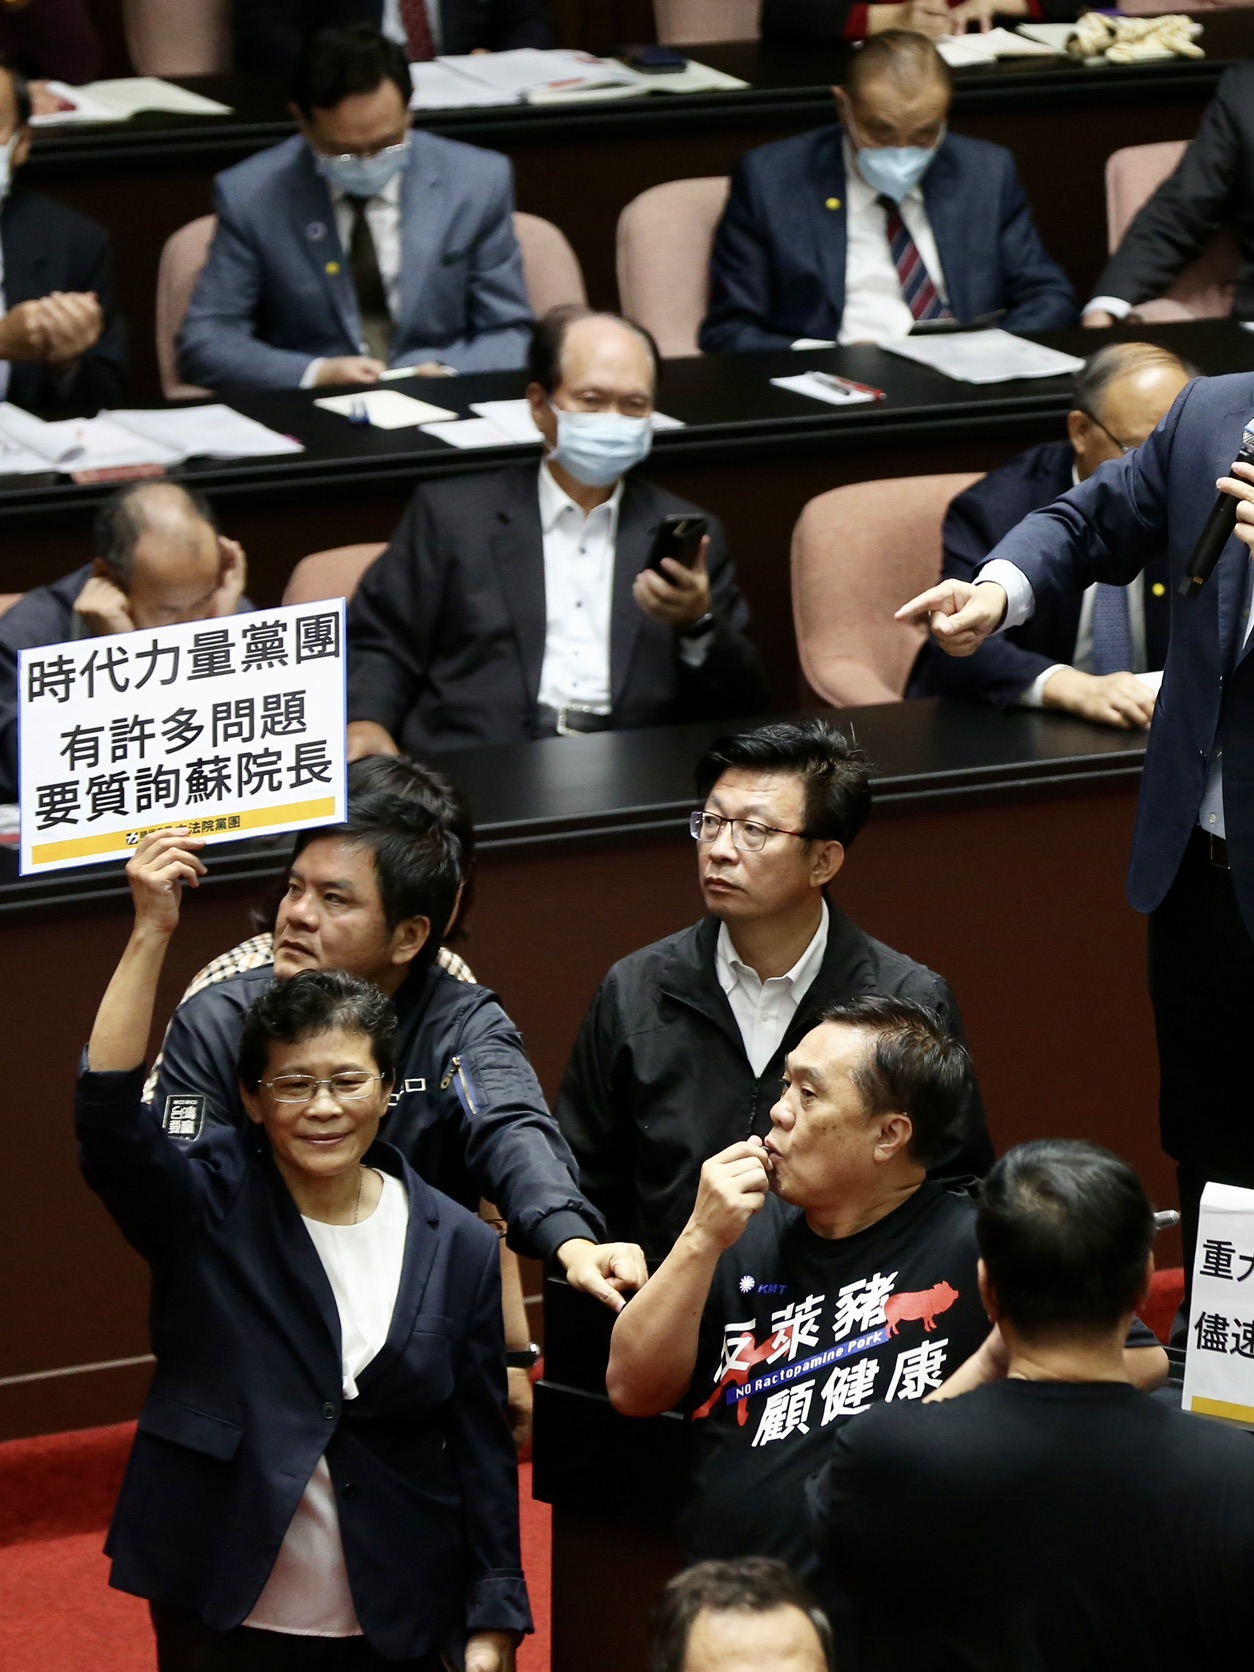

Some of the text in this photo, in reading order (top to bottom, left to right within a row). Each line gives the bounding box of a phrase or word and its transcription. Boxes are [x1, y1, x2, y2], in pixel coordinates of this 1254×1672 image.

[28, 611, 340, 703] 時代力量黨團
[59, 689, 307, 772] 有許多問題
[35, 739, 333, 831] 要質詢蘇院長
[757, 1283, 788, 1295] KMT
[751, 1338, 949, 1448] 顧健康
[755, 1346, 844, 1392] Ractopamine
[848, 1331, 883, 1353] Pork
